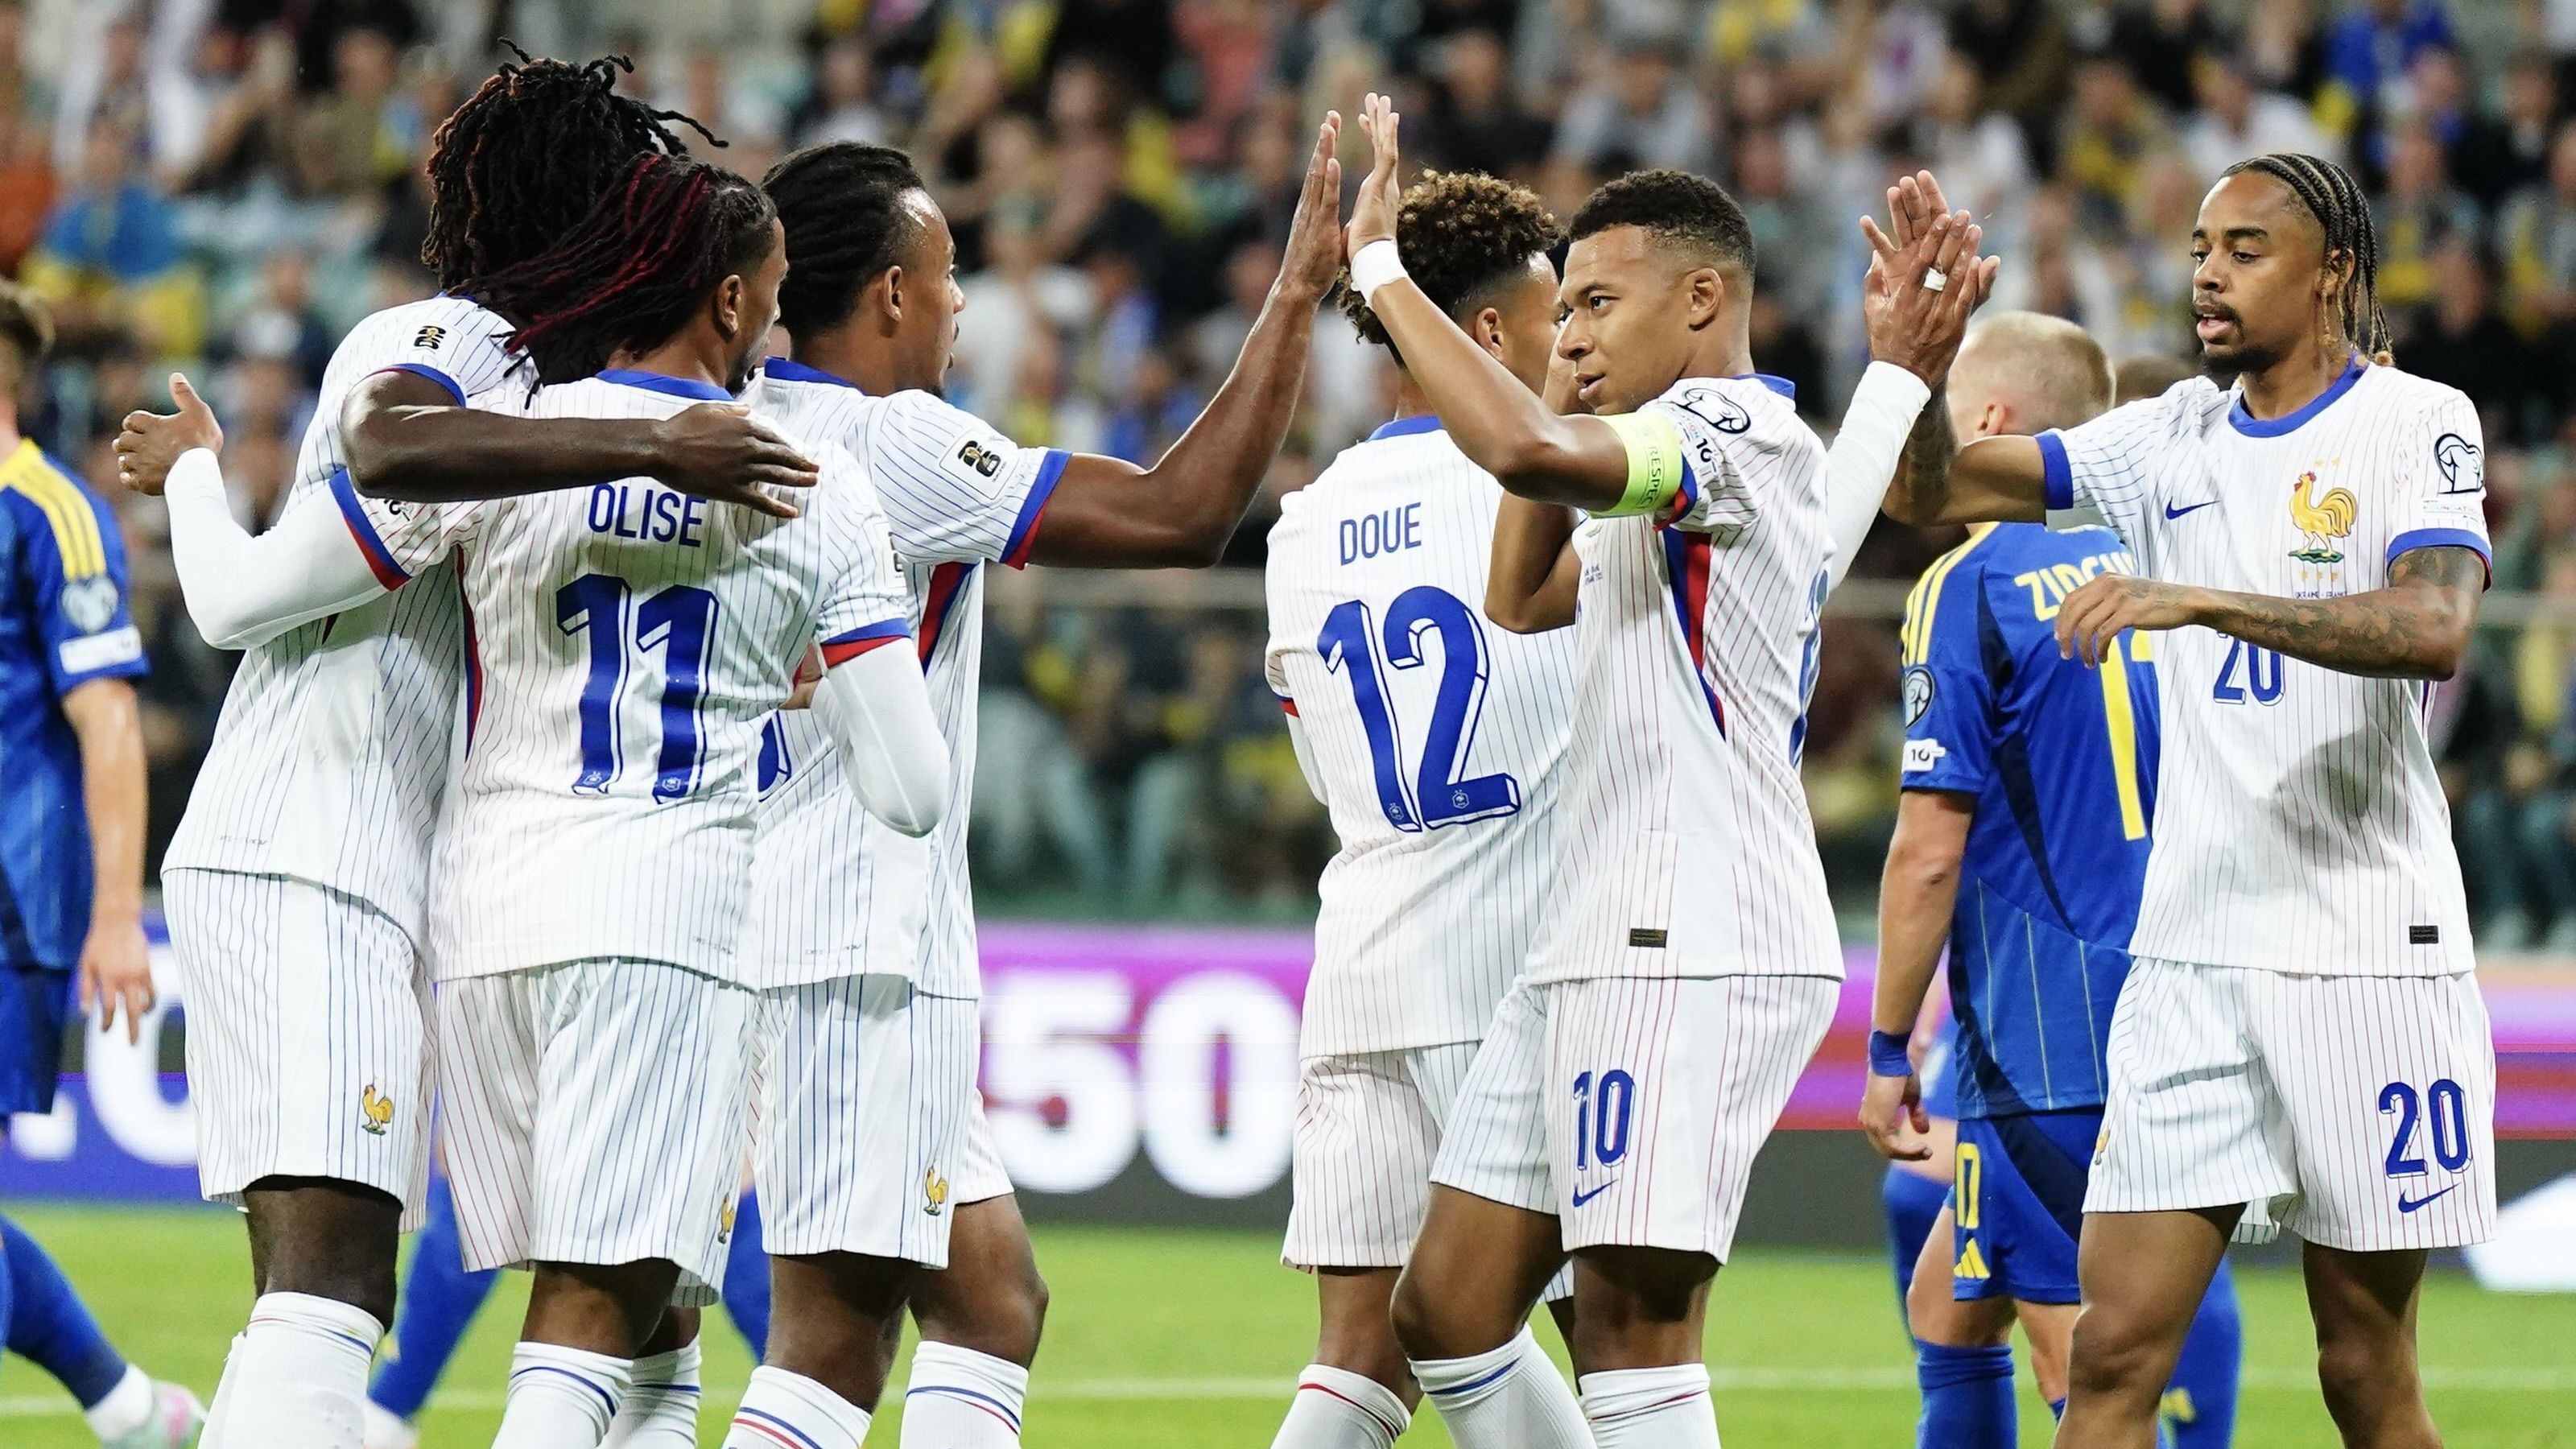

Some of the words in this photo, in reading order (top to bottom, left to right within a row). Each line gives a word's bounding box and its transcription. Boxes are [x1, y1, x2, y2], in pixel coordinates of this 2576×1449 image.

[588, 483, 707, 548] OLISE
[1340, 502, 1422, 567] DOUE
[555, 573, 720, 805] 11
[1317, 585, 1521, 832] 12
[2214, 630, 2285, 706] 20
[980, 968, 1302, 1199] 50
[1572, 1069, 1637, 1170] 10
[2379, 1079, 2474, 1179] 20
